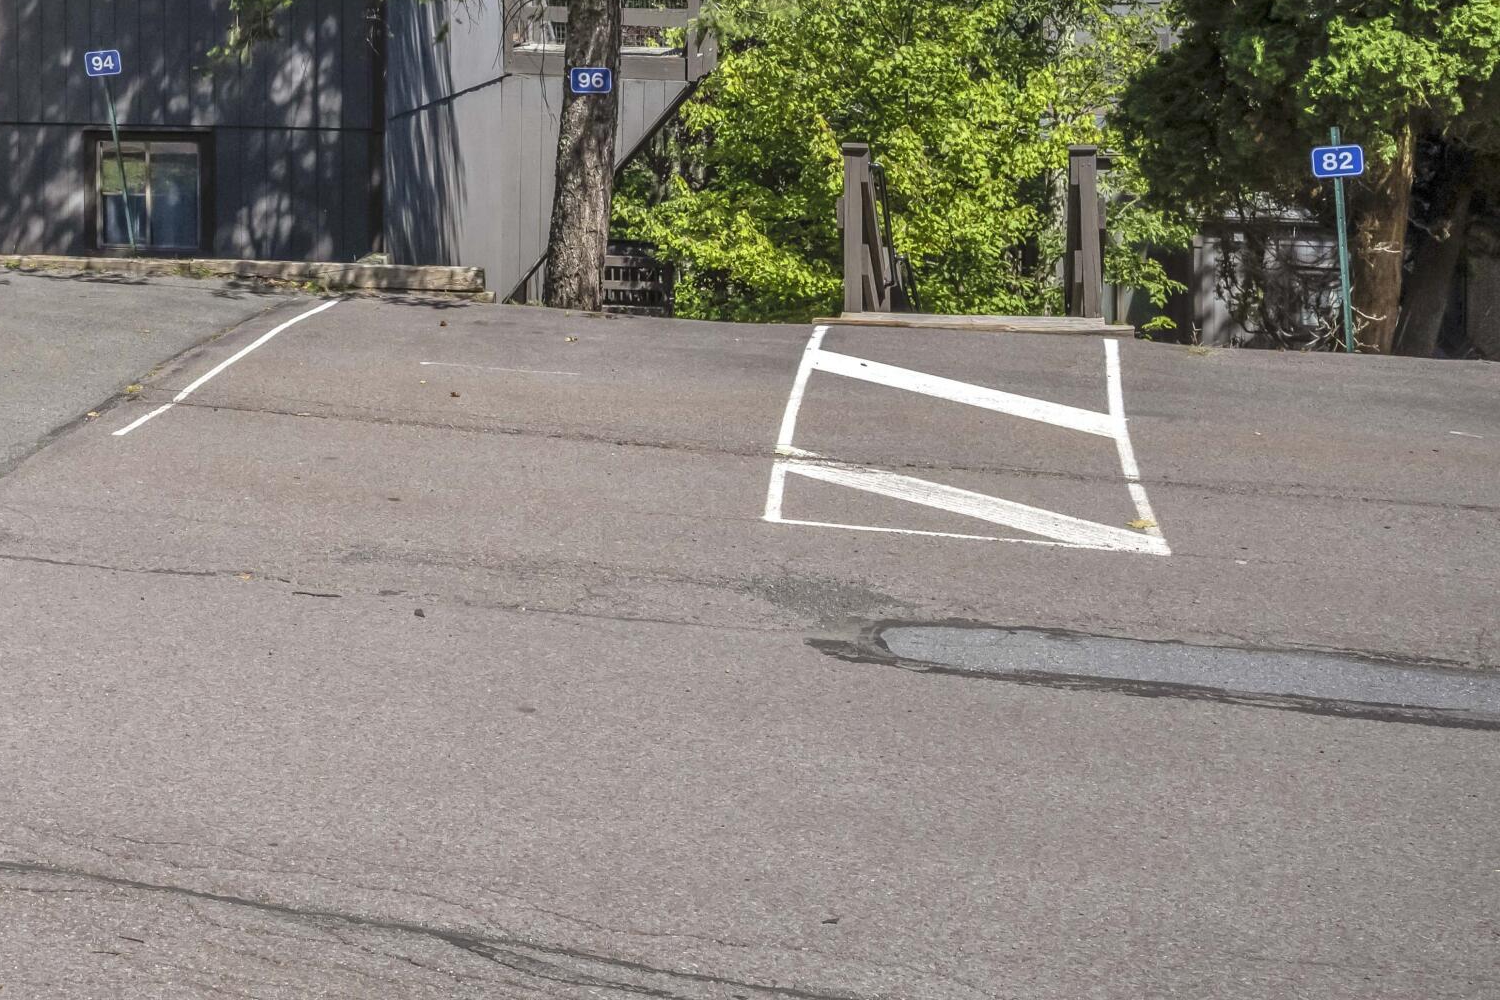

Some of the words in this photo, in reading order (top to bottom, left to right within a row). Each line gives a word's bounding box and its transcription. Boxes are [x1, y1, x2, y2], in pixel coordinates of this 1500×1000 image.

[91, 55, 115, 71] 94
[578, 72, 604, 88] 96
[1322, 151, 1354, 171] 82
